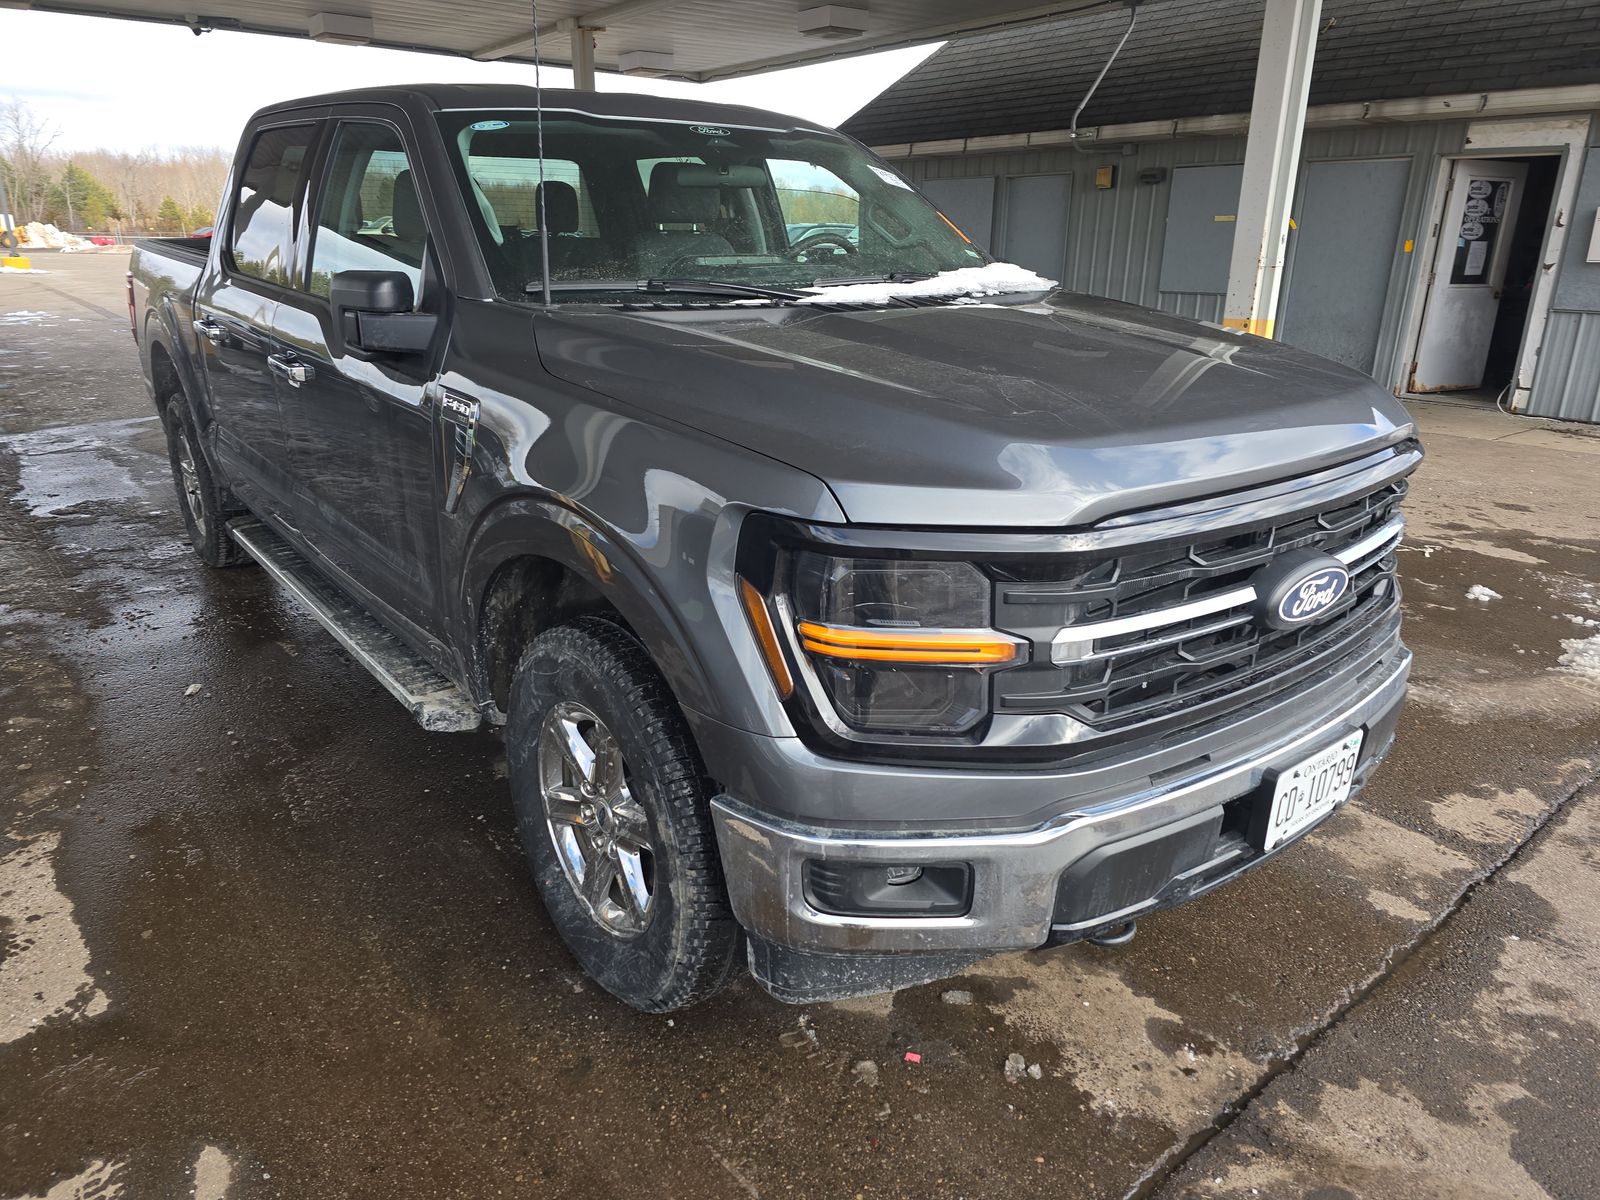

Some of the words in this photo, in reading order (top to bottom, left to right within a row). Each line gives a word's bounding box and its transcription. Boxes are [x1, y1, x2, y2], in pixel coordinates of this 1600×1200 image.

[698, 126, 723, 135] Ford
[1292, 576, 1338, 616] Ford
[1304, 751, 1338, 778] ONTARIO
